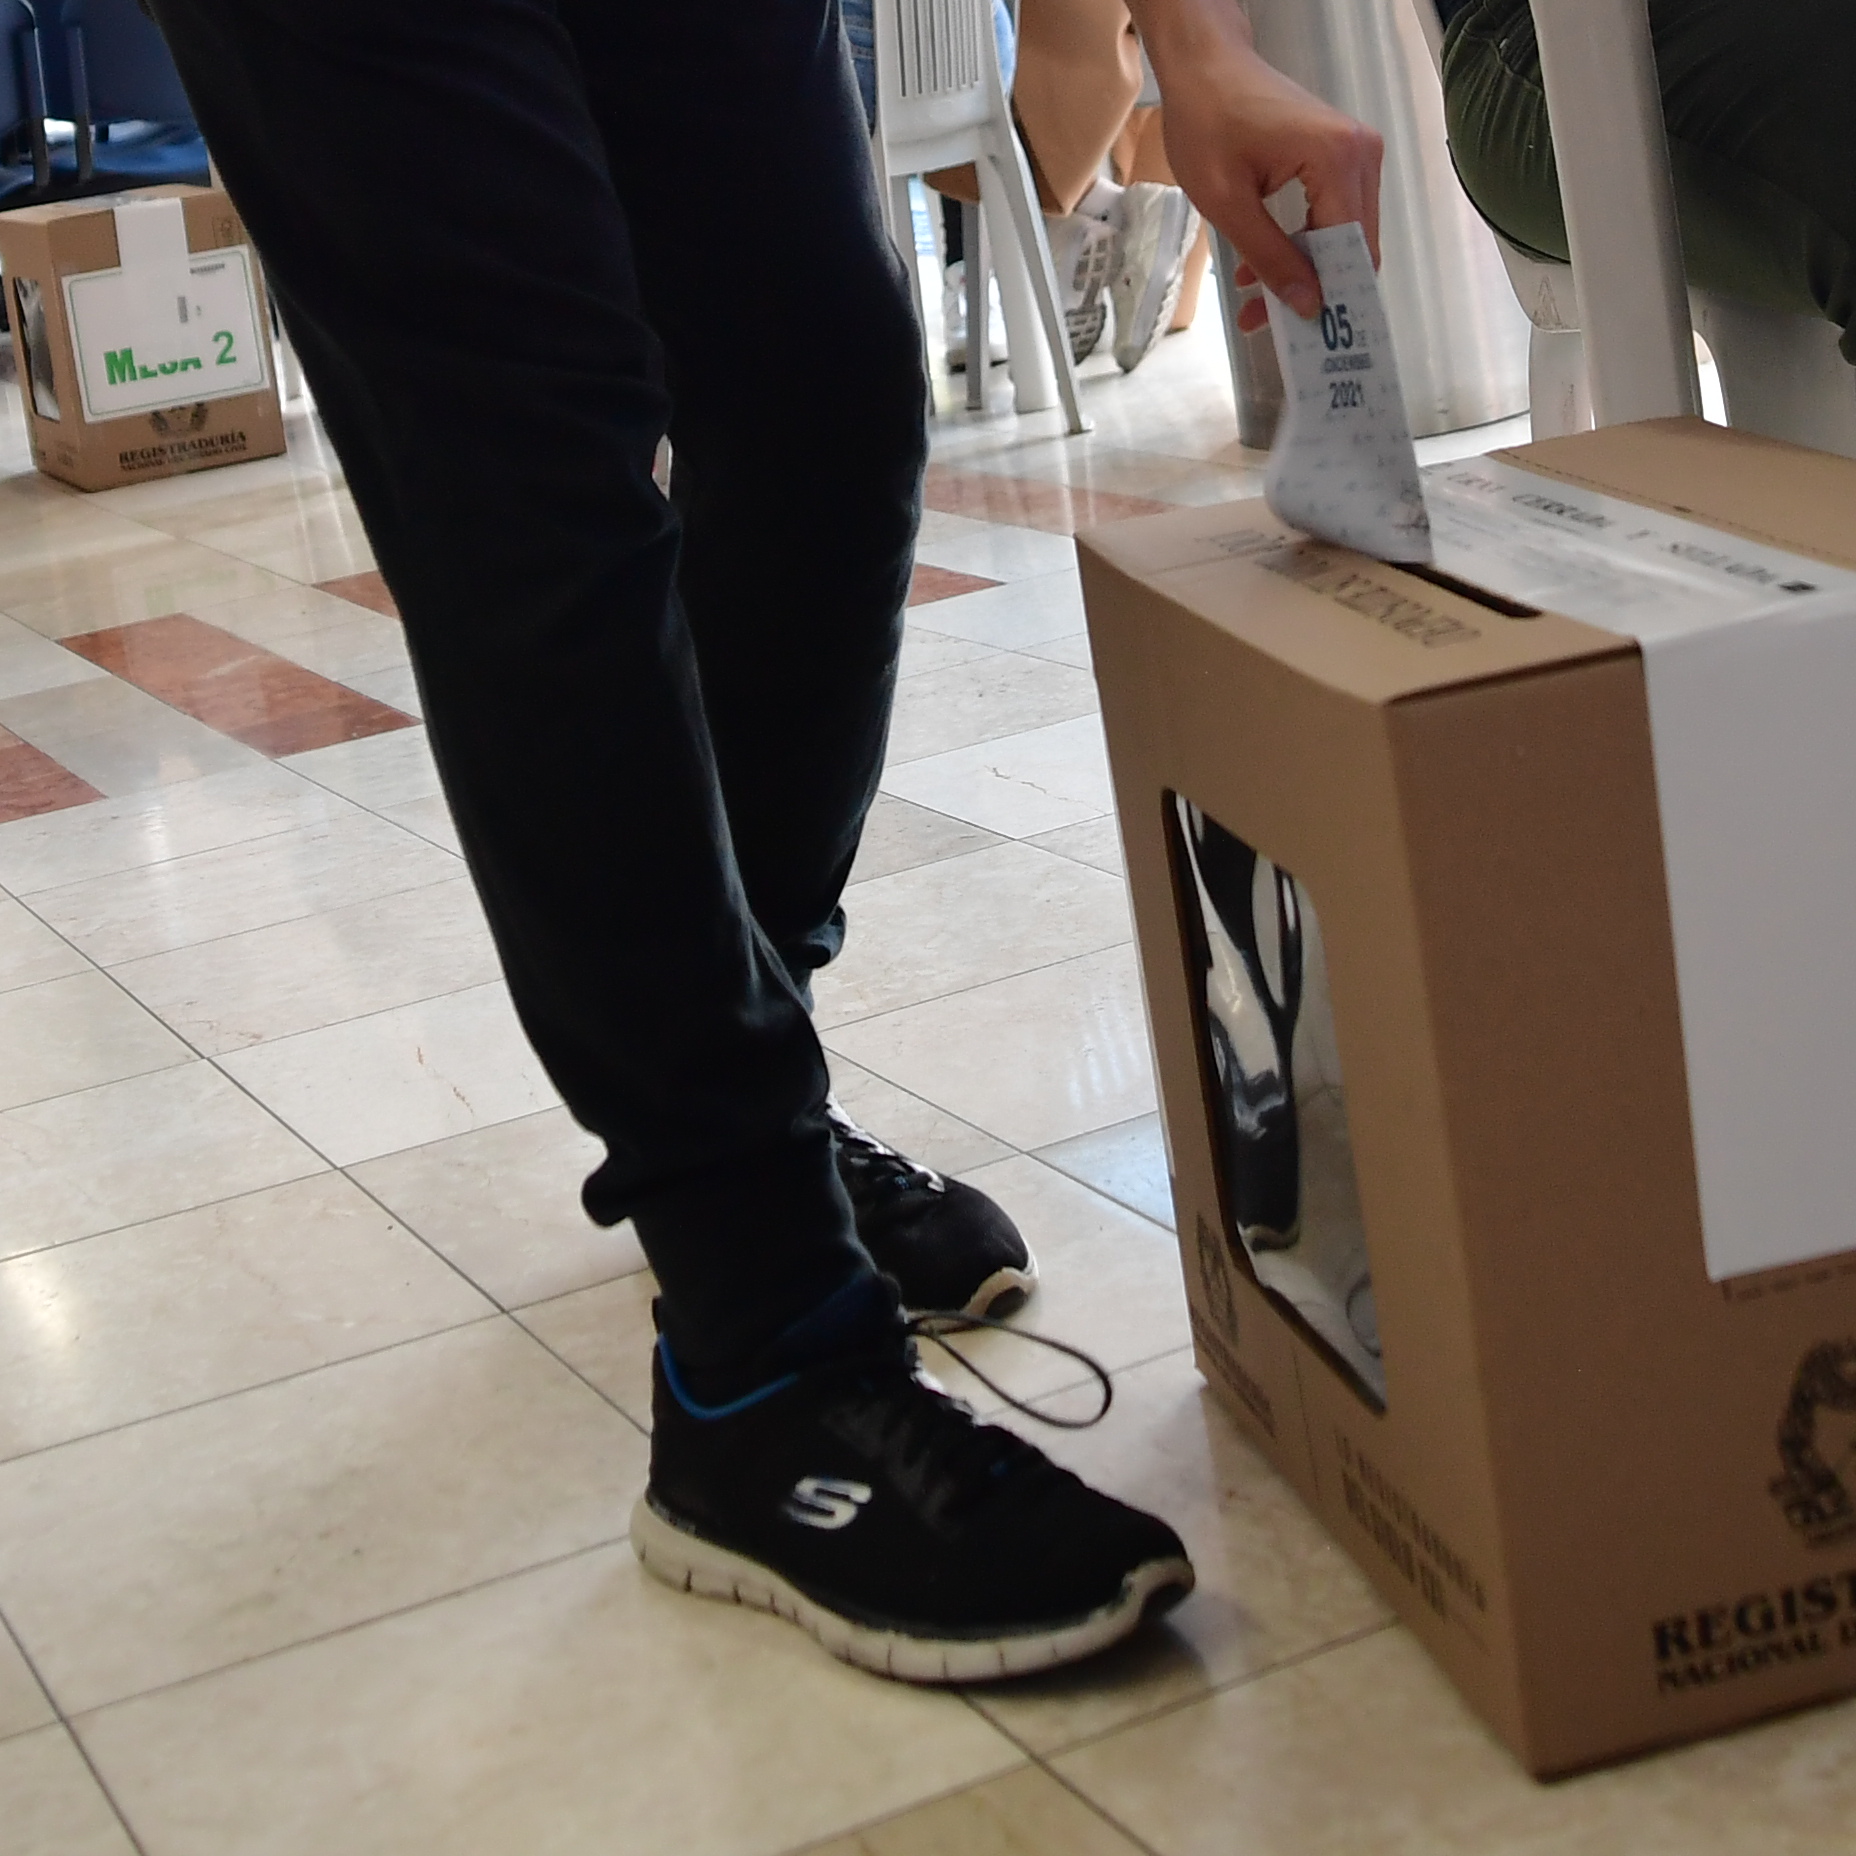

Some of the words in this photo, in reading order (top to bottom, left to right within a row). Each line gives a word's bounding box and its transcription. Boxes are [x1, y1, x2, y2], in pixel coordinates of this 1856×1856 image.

[1322, 303, 1353, 351] 05
[212, 331, 238, 365] 2
[119, 429, 246, 464] REGISTRADURÍA
